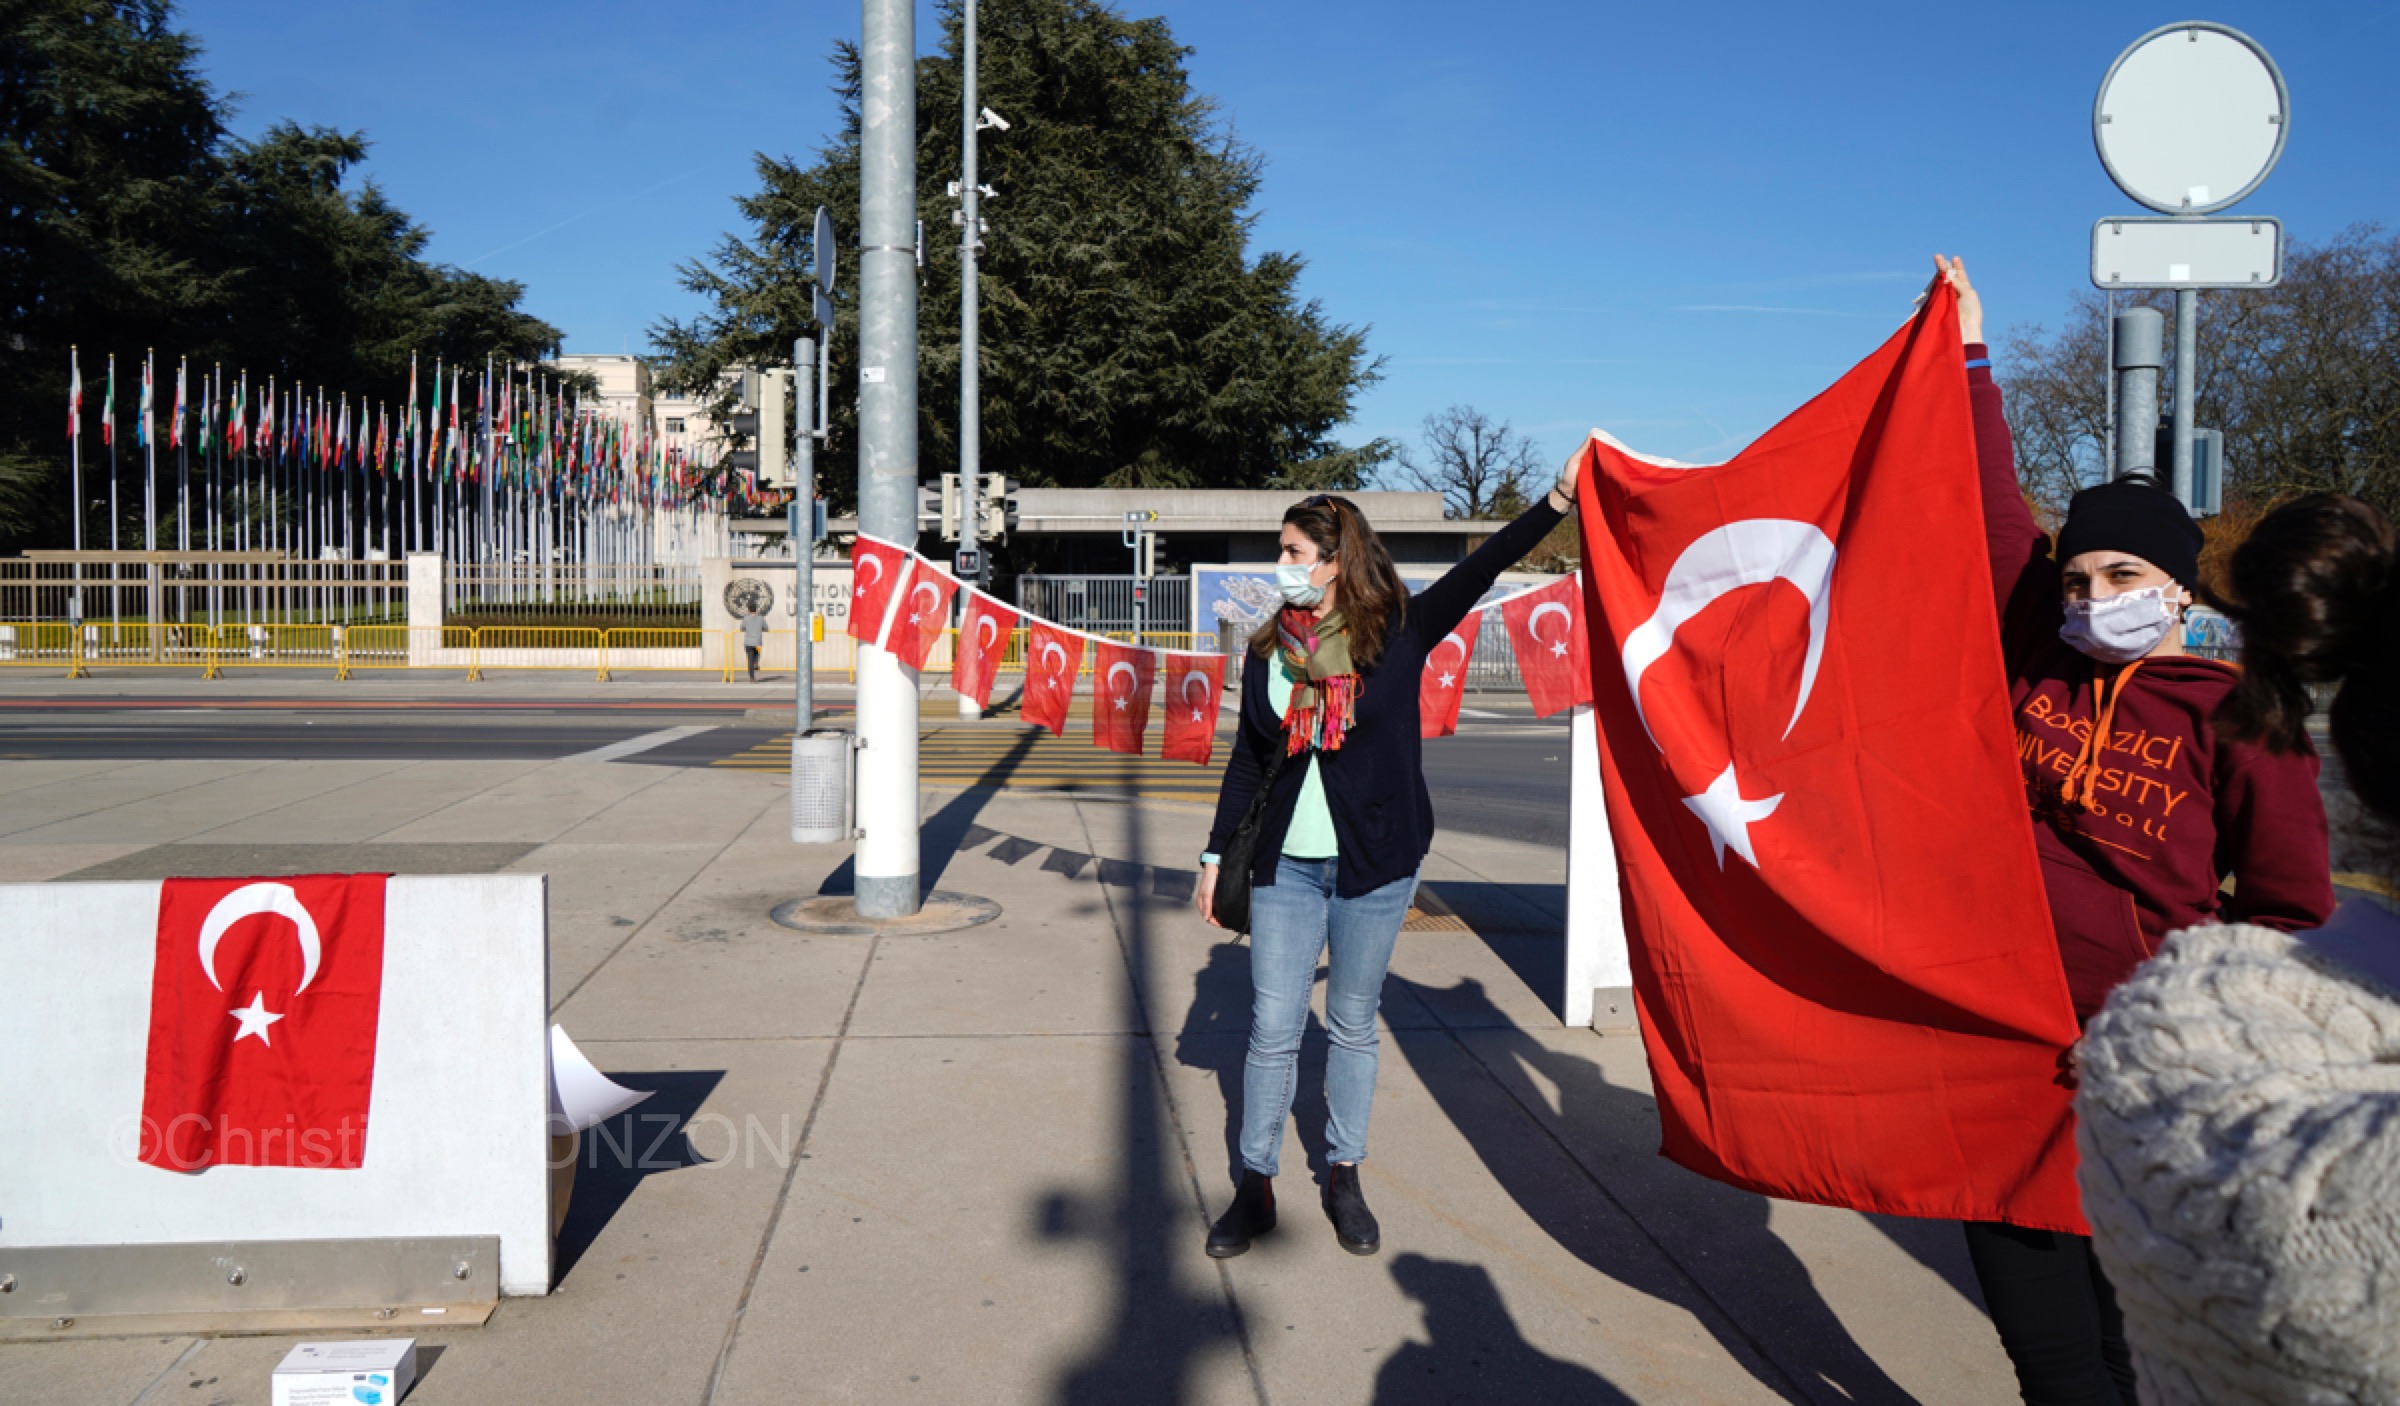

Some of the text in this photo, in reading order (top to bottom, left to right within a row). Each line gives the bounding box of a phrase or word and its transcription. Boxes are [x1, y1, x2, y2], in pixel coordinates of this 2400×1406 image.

[786, 583, 852, 599] NTION
[786, 603, 847, 617] UTED
[2018, 730, 2188, 816] NIVERSITY
